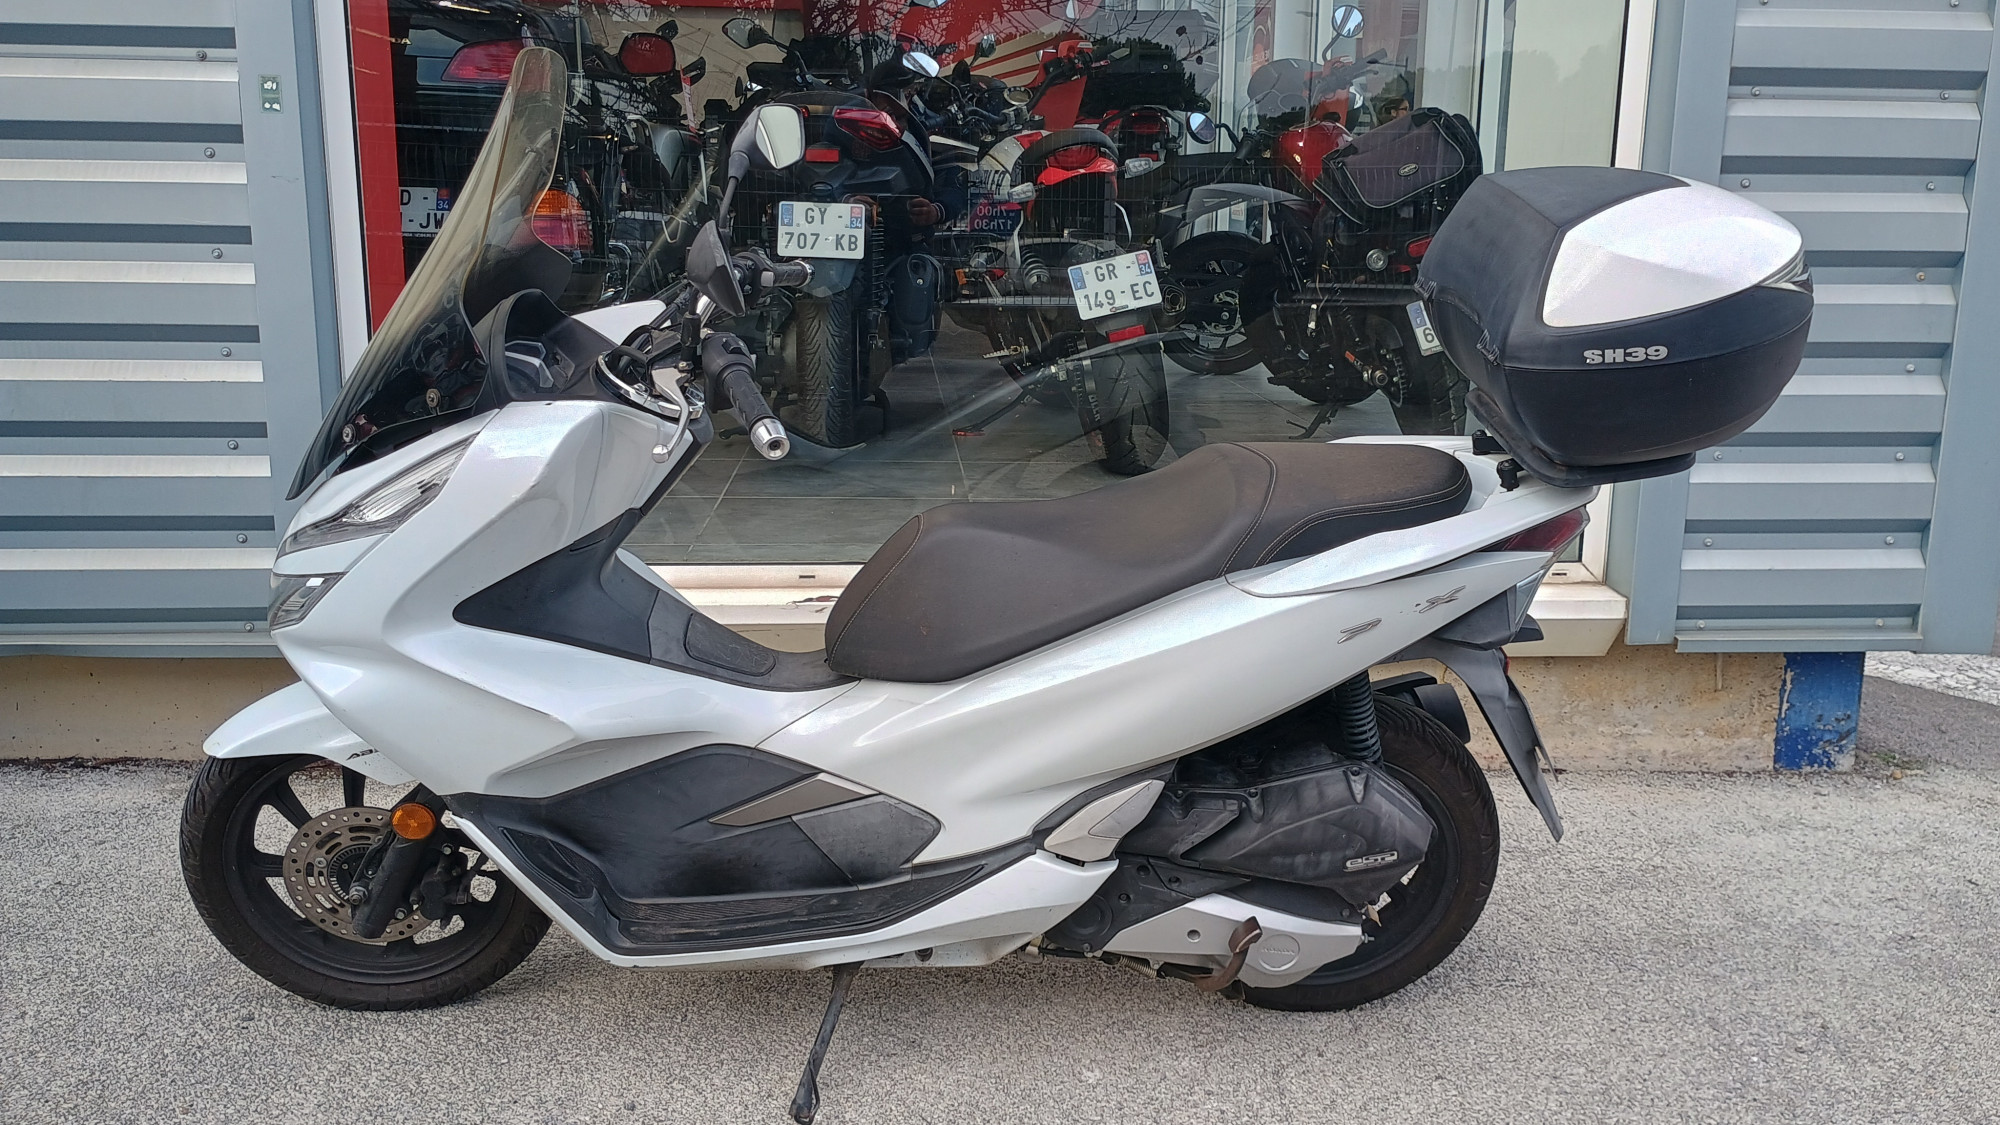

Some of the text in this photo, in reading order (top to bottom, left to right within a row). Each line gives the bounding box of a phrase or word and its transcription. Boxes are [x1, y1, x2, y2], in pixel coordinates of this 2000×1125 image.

[437, 200, 450, 210] 34
[850, 217, 863, 229] 34
[1139, 263, 1152, 275] 34
[1583, 345, 1669, 364] SH39
